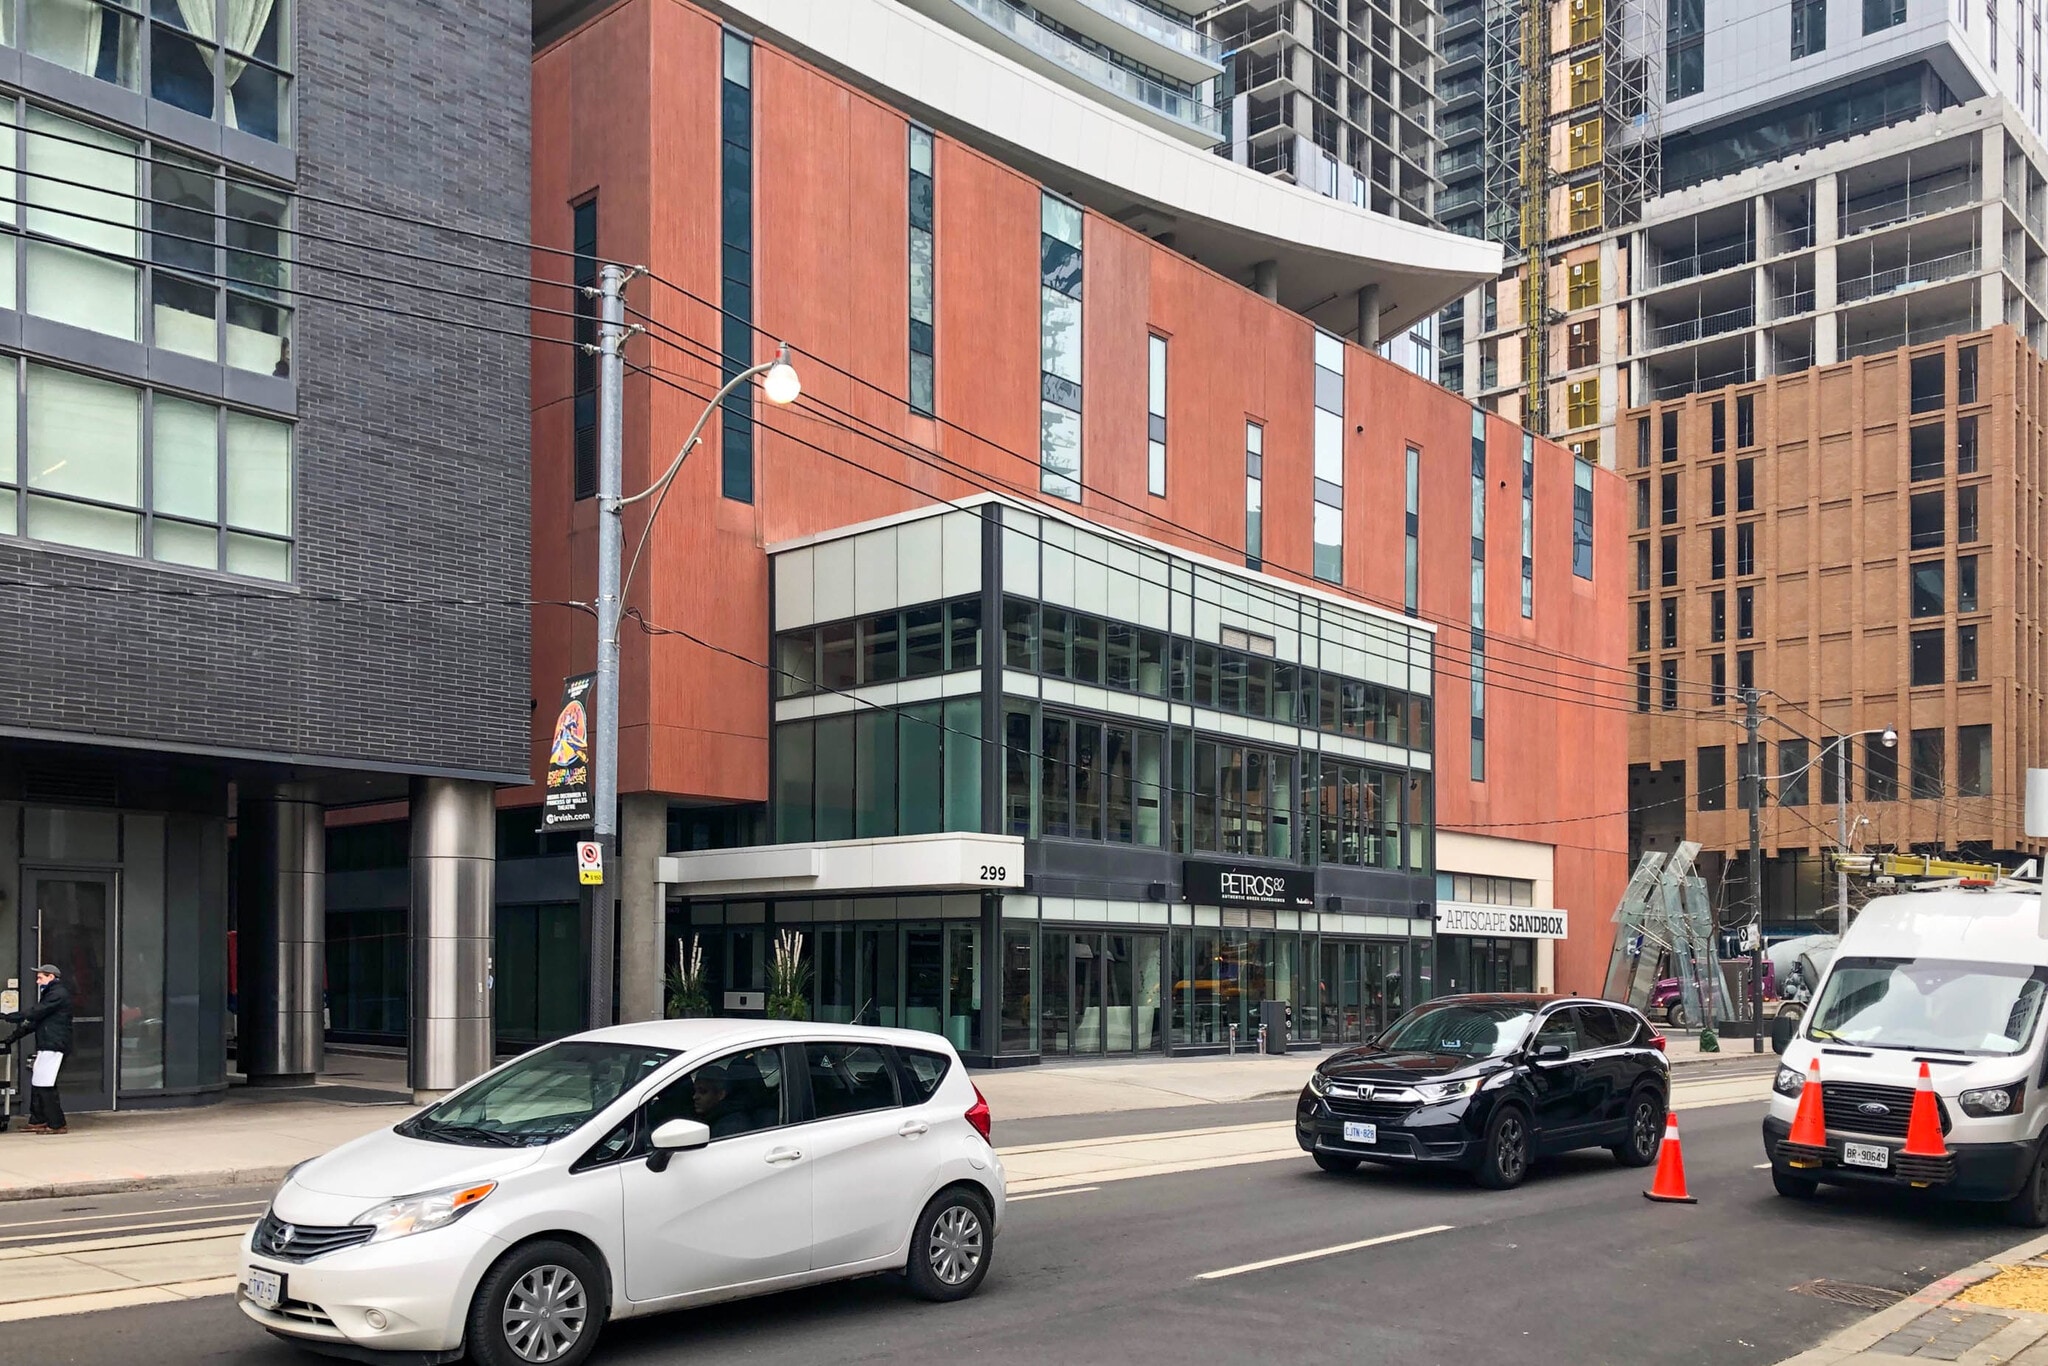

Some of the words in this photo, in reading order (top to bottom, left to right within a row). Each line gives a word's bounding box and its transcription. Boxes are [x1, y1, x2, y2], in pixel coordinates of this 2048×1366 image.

[980, 865, 1006, 881] 299
[1446, 909, 1507, 932] ARTSCAPE
[1509, 913, 1563, 935] SANDBOX
